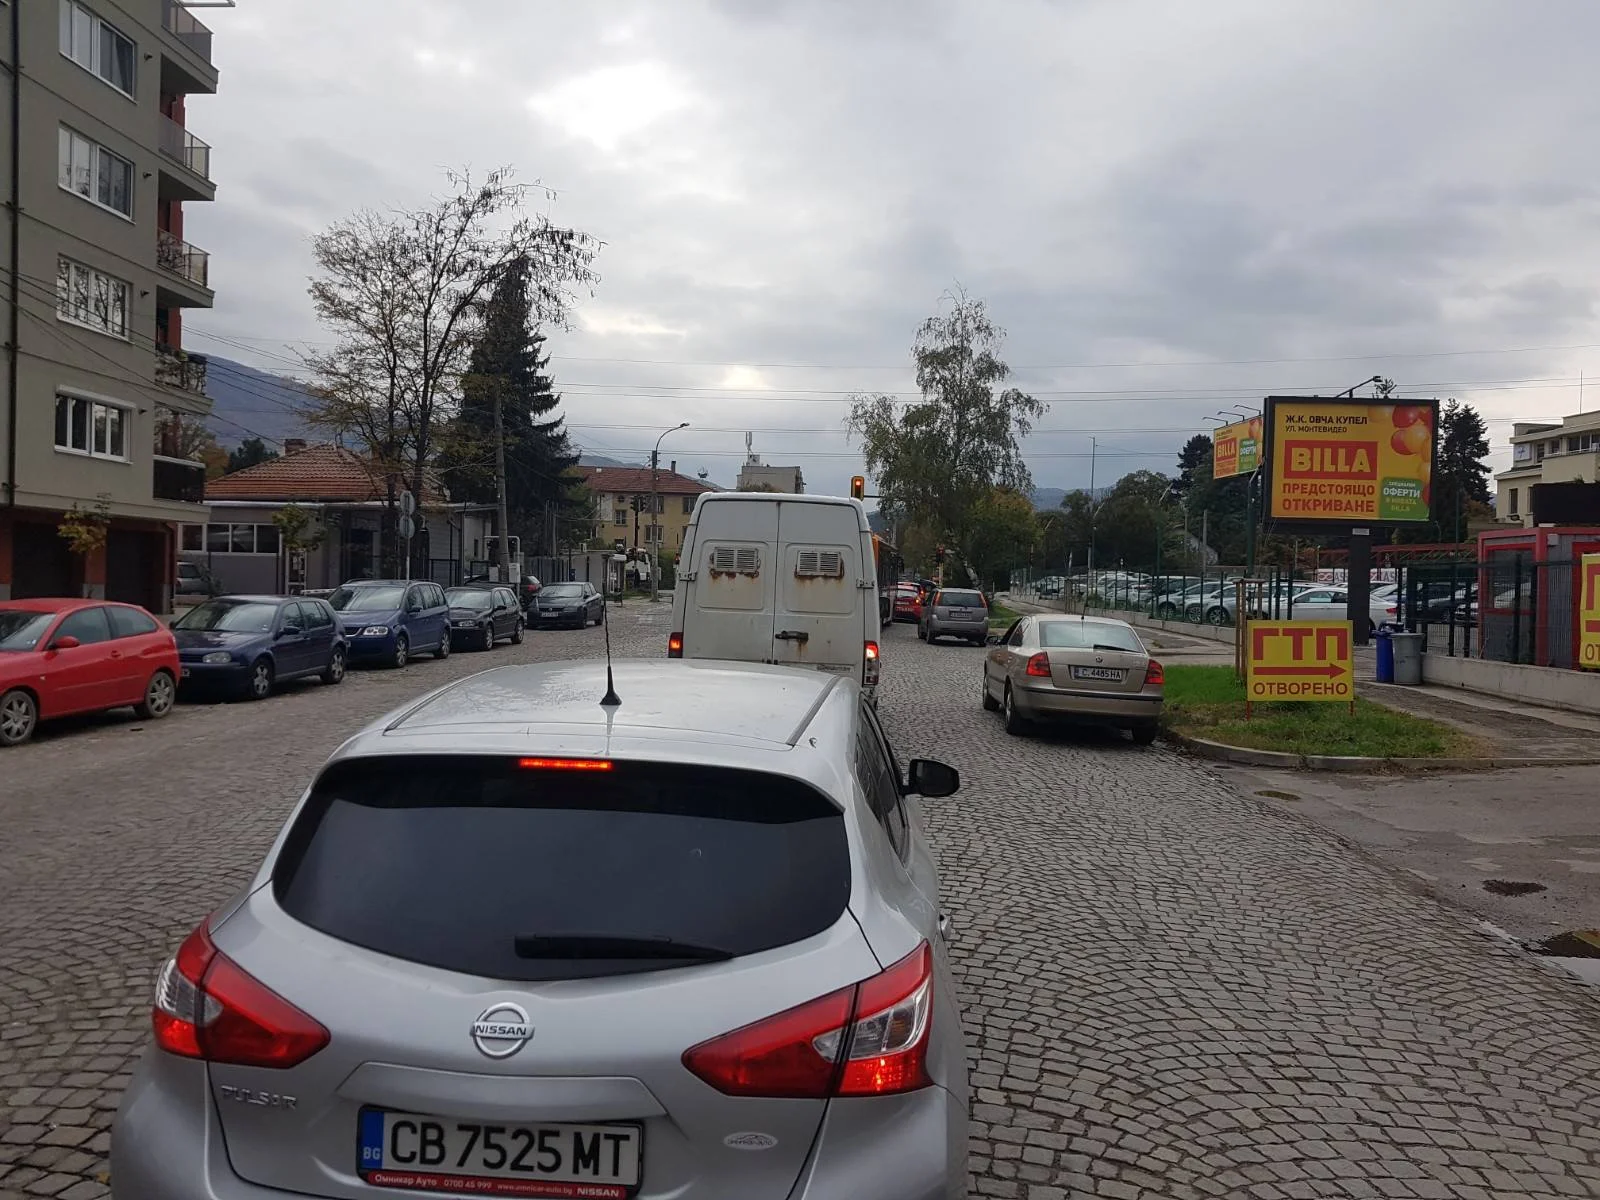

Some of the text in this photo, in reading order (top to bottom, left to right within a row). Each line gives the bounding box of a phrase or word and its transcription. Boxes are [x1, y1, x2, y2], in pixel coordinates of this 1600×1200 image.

[1309, 415, 1335, 424] ОВЧА
[1336, 416, 1368, 425] КУПЕЛ
[1285, 425, 1348, 434] УЛ. МОНТЕВИДЕО
[1290, 447, 1372, 473] BILLA
[1282, 483, 1376, 497] ПРЕДСТОЯЩО
[1383, 487, 1421, 498] ОФЕРТИ
[1282, 498, 1375, 513] ОТКРИВАНЕ
[1253, 628, 1348, 660] ГТП
[1253, 682, 1348, 696] ОТВОРЕНО
[475, 1024, 527, 1036] NISSAN
[362, 1120, 631, 1178] BG CB 7525 MT
[415, 1178, 438, 1188] Ауто
[443, 1179, 464, 1189] 0700
[464, 1181, 475, 1189] 45
[476, 1182, 492, 1190] 999
[577, 1187, 620, 1198] NISSAN
